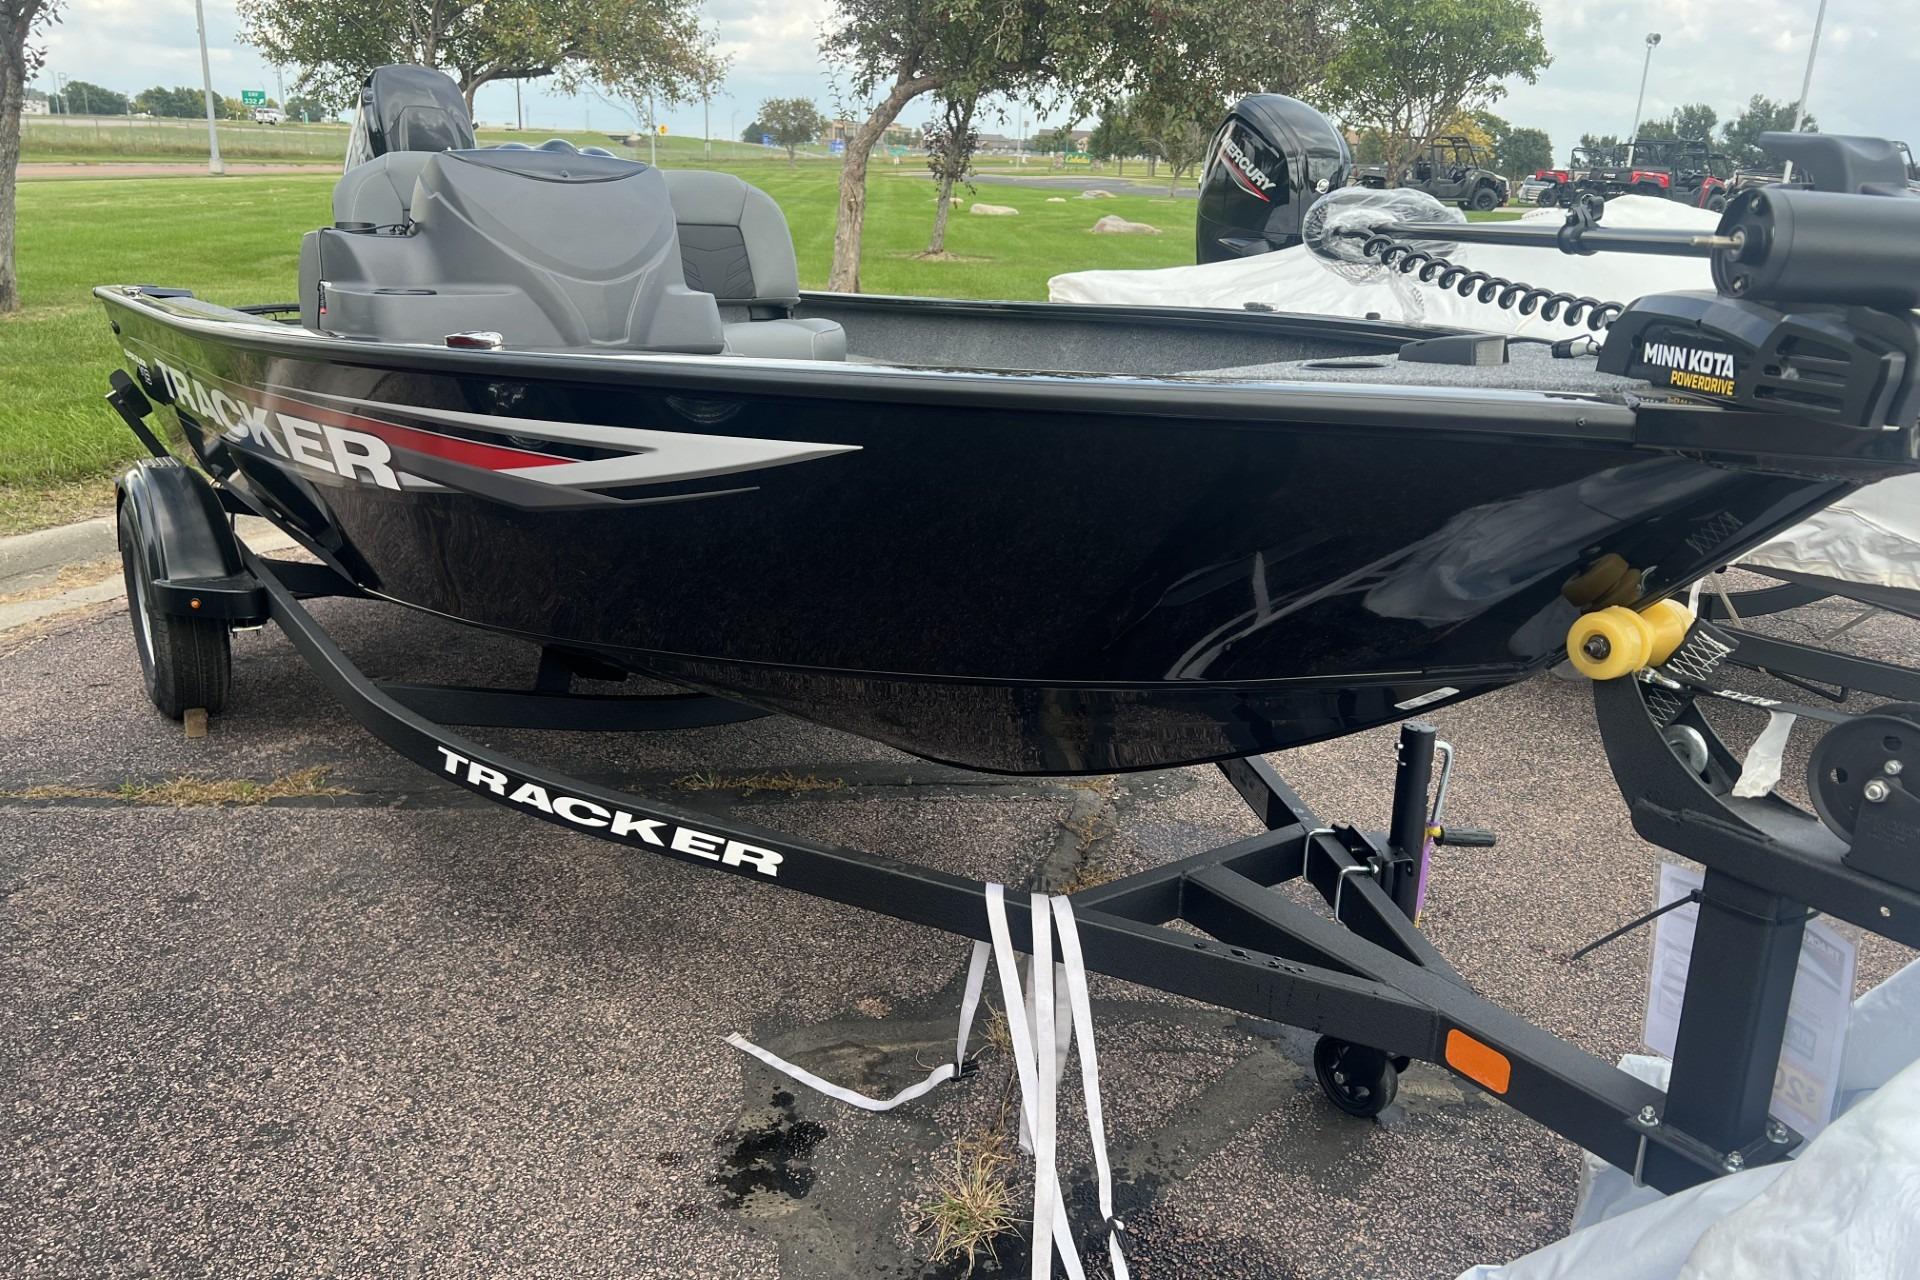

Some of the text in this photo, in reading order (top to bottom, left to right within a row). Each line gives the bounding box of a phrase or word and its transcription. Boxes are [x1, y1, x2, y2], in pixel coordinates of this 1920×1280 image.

[1221, 138, 1276, 190] MERCURY
[1643, 342, 1734, 379] MINN KOTA
[1670, 370, 1735, 396] POWERDRIVE
[154, 358, 402, 491] TRACKER
[437, 746, 784, 877] TRACKER
